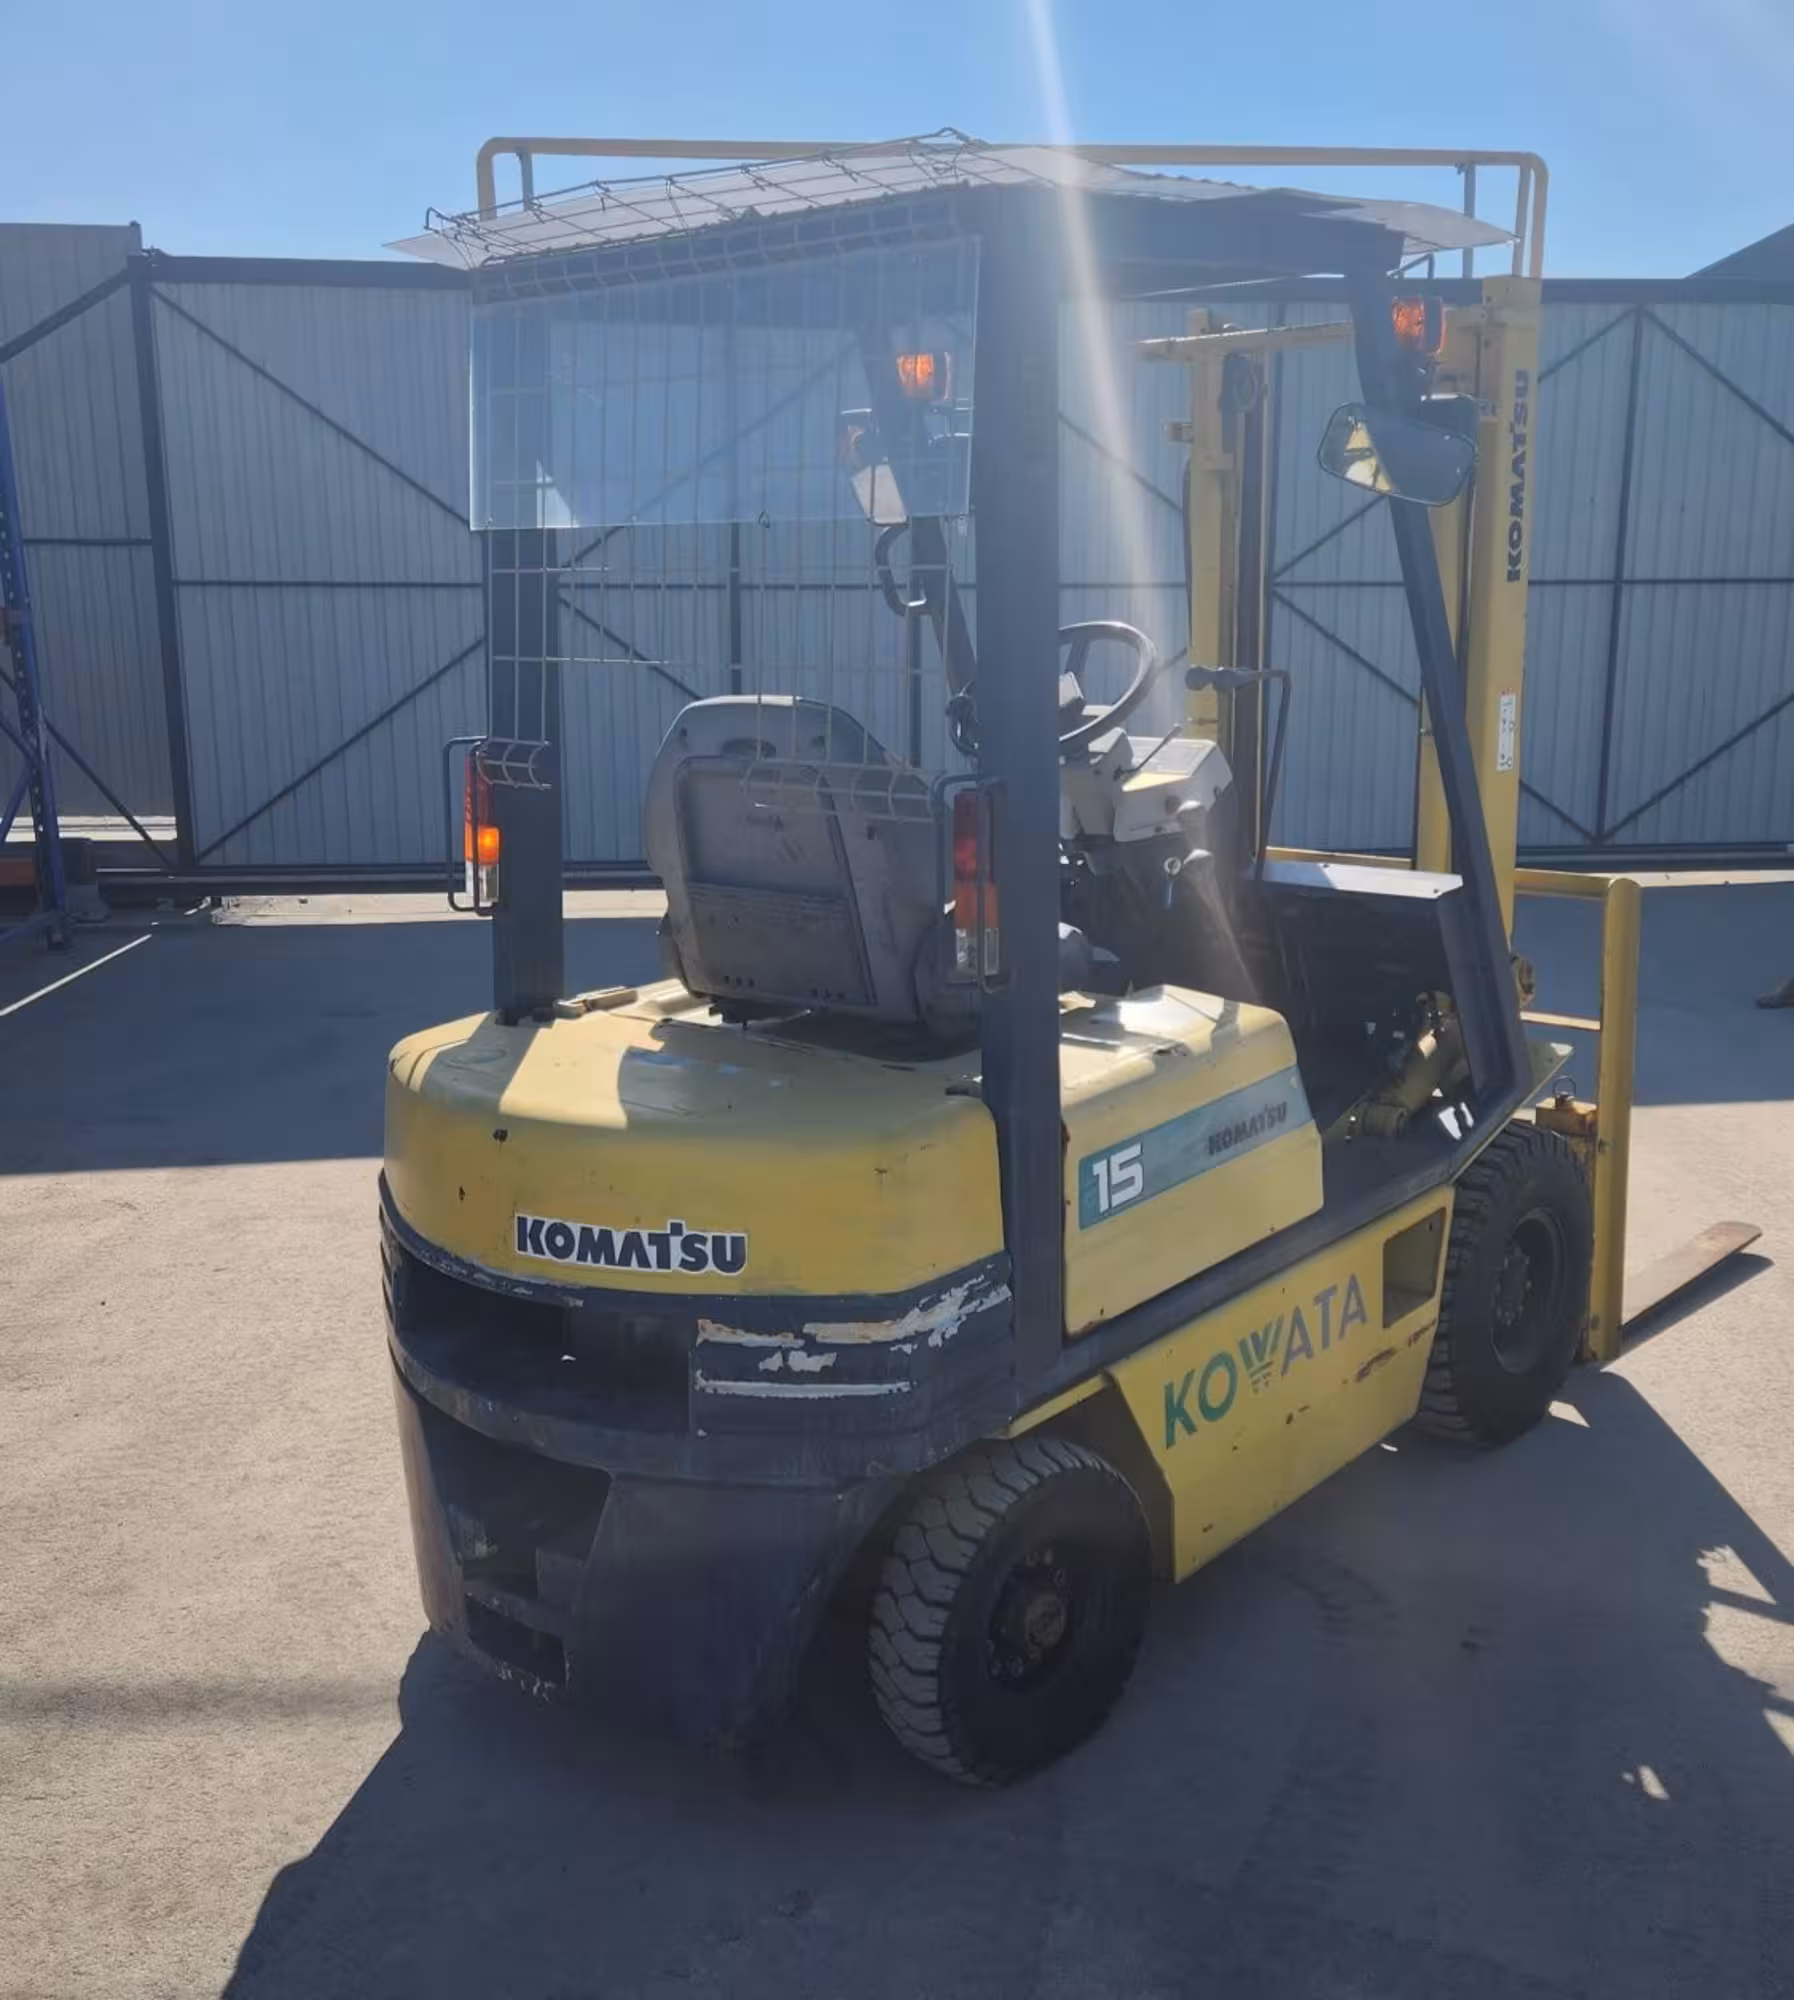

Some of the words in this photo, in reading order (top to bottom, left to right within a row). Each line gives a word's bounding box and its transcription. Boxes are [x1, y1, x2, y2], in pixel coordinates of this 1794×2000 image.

[1507, 369, 1530, 582] KOMATSU
[1208, 1101, 1288, 1156] KOMATSU
[1092, 1142, 1145, 1214] 15
[515, 1215, 746, 1275] KOMATSU
[1164, 1272, 1369, 1449] KOWATA
